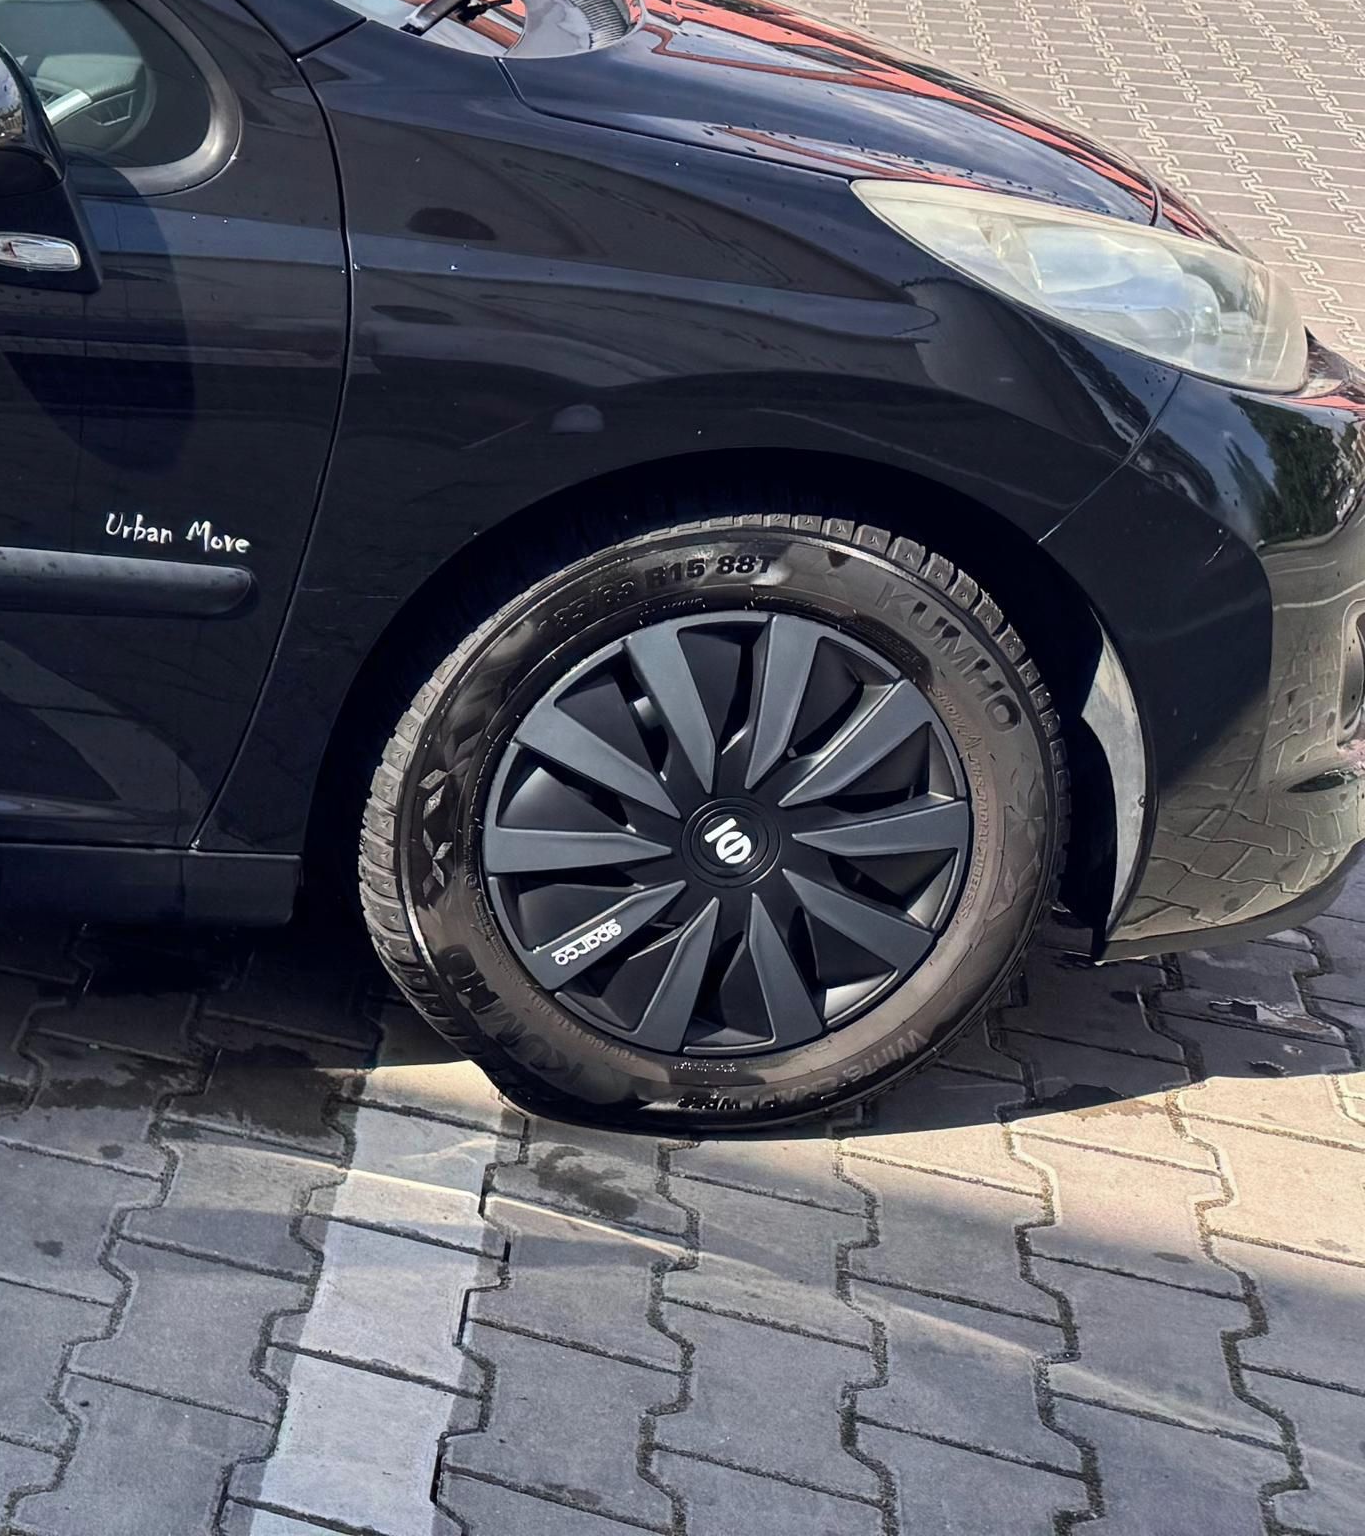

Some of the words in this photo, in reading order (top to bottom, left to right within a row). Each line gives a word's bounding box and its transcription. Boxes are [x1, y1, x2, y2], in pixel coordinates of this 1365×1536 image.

[105, 512, 173, 544] Urban
[185, 520, 251, 553] Move
[644, 558, 706, 590] R15
[715, 552, 774, 578] 88T
[875, 581, 1022, 734] KUMHO
[553, 920, 622, 966] sparco
[436, 943, 584, 1088] KUMHO
